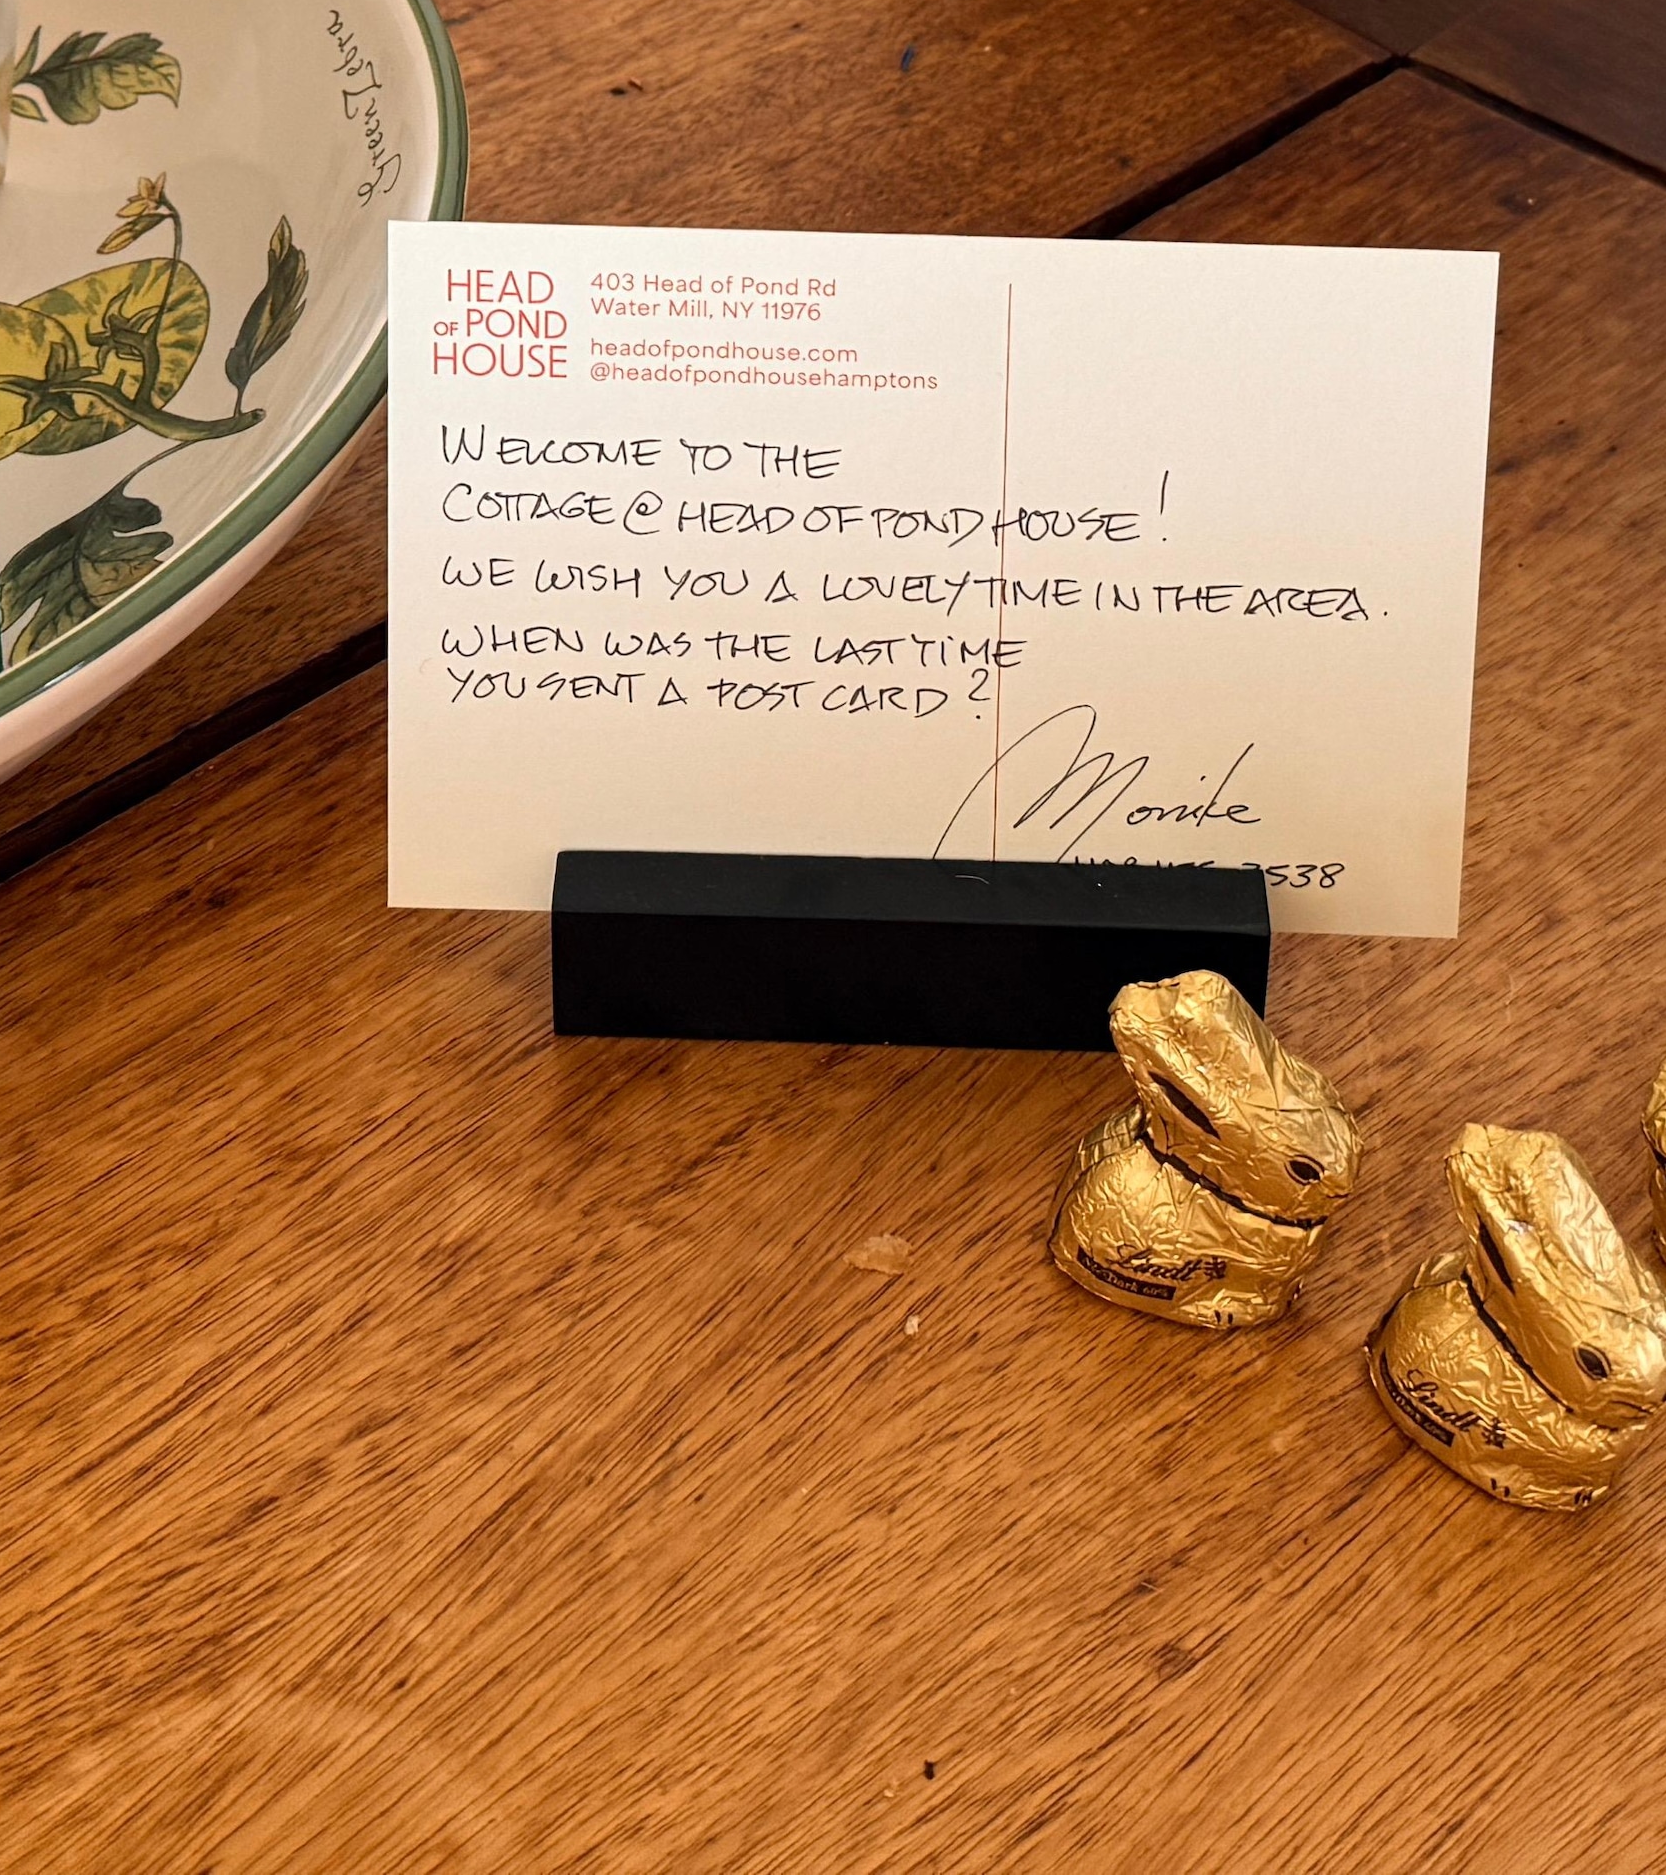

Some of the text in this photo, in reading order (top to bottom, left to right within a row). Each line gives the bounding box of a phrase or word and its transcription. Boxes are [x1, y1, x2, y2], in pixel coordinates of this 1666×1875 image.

[448, 269, 554, 303] HEAD
[591, 273, 835, 296] 403 Head of Pond Rd
[434, 308, 567, 338] OF POND
[591, 298, 820, 321] Water Mill, NY 11976
[434, 342, 567, 378] HOUSE
[591, 338, 857, 362] headofpondhouse.com
[591, 362, 937, 391] @headofpondhousehamptons
[680, 438, 732, 475] TO
[743, 442, 841, 479] THE
[442, 555, 1388, 621] WE WISH YOU A LOVELY TIME IN THE AREA.
[442, 625, 1027, 667] WHEN WAS THE LAST TIME
[1399, 1369, 1481, 1433] Lindt
